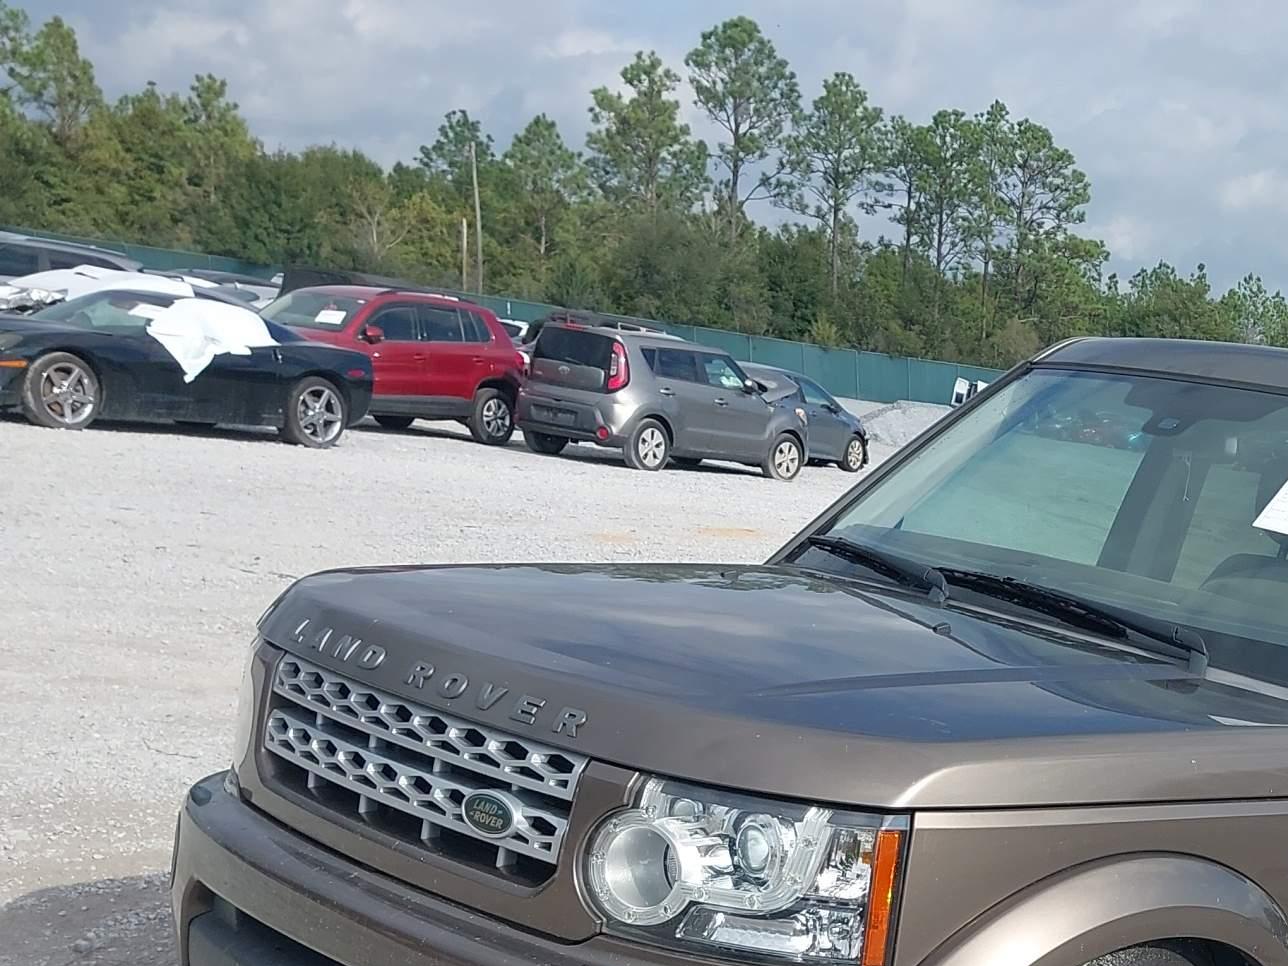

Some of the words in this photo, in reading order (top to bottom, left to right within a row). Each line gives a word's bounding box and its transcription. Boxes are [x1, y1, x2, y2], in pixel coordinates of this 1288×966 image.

[290, 618, 387, 670] LAND
[403, 660, 588, 738] ROVER
[472, 799, 498, 815] LAND
[473, 810, 504, 829] ROVER
